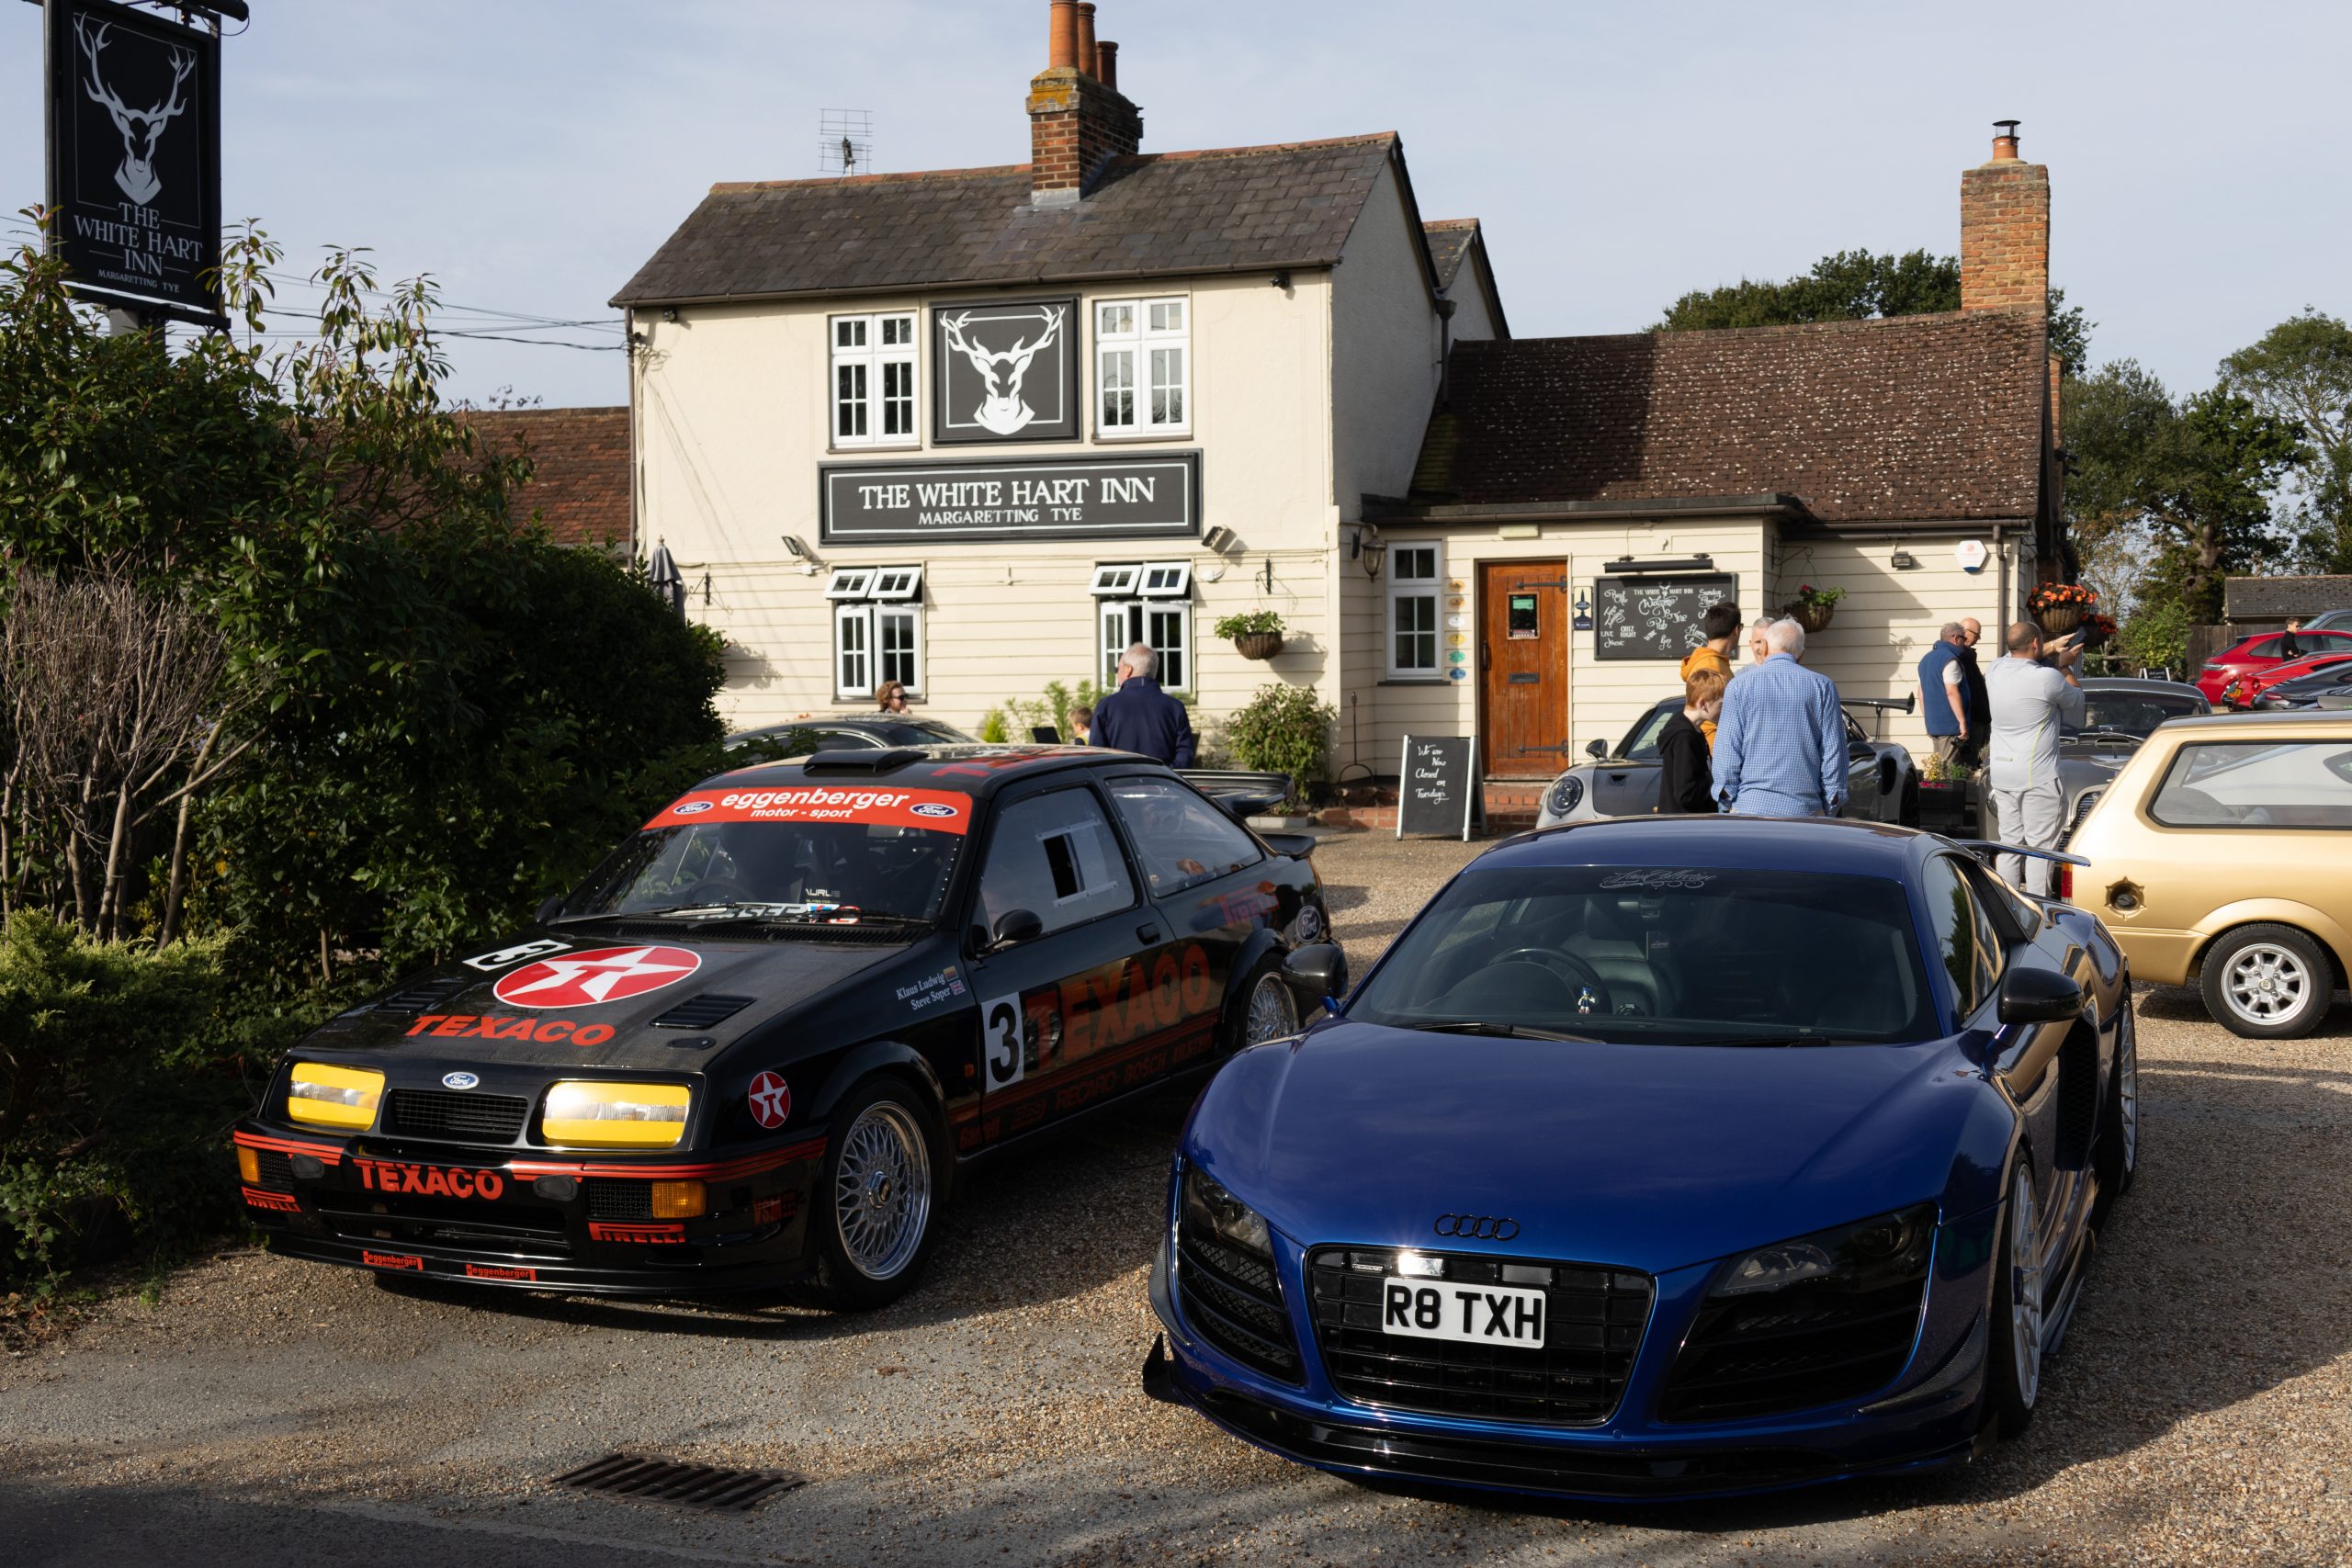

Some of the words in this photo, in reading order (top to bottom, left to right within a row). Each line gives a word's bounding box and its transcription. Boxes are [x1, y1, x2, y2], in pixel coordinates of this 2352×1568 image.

[119, 202, 160, 229] THE
[74, 215, 140, 249] WHITE
[147, 232, 203, 262] HART
[124, 249, 163, 276] INN
[98, 268, 158, 288] MARGARETTING
[162, 281, 180, 293] TYE
[858, 483, 910, 510] THE
[916, 481, 1001, 508] WHITE
[1012, 479, 1089, 506] HART
[1102, 477, 1156, 504] INN
[919, 508, 1039, 525] MARGARETTING
[1051, 507, 1082, 522] TYE
[1418, 744, 1436, 756] We
[1431, 757, 1446, 766] Now
[1416, 768, 1439, 778] Closed
[721, 788, 910, 810] eggenberger
[750, 808, 797, 818] motor
[809, 808, 853, 819] sport
[478, 944, 558, 966] 3
[896, 984, 919, 999] Klaus
[918, 973, 946, 991] Ludwig
[910, 996, 932, 1010] Steve
[930, 987, 951, 1001] Soper
[1024, 944, 1211, 1070] TEXACO
[405, 1015, 615, 1046] TEXACO
[989, 1002, 1020, 1083] 3
[1056, 1070, 1118, 1111] RECARO
[1124, 1052, 1168, 1084] BOSCH
[353, 1158, 503, 1200] TEXACO
[242, 1186, 303, 1213] PIRELLI
[588, 1222, 685, 1244] PIRELLI
[368, 1254, 417, 1267] eggenberger
[472, 1268, 530, 1279] eggenberger
[1385, 1284, 1442, 1330] R8
[1455, 1291, 1543, 1340] TXH
